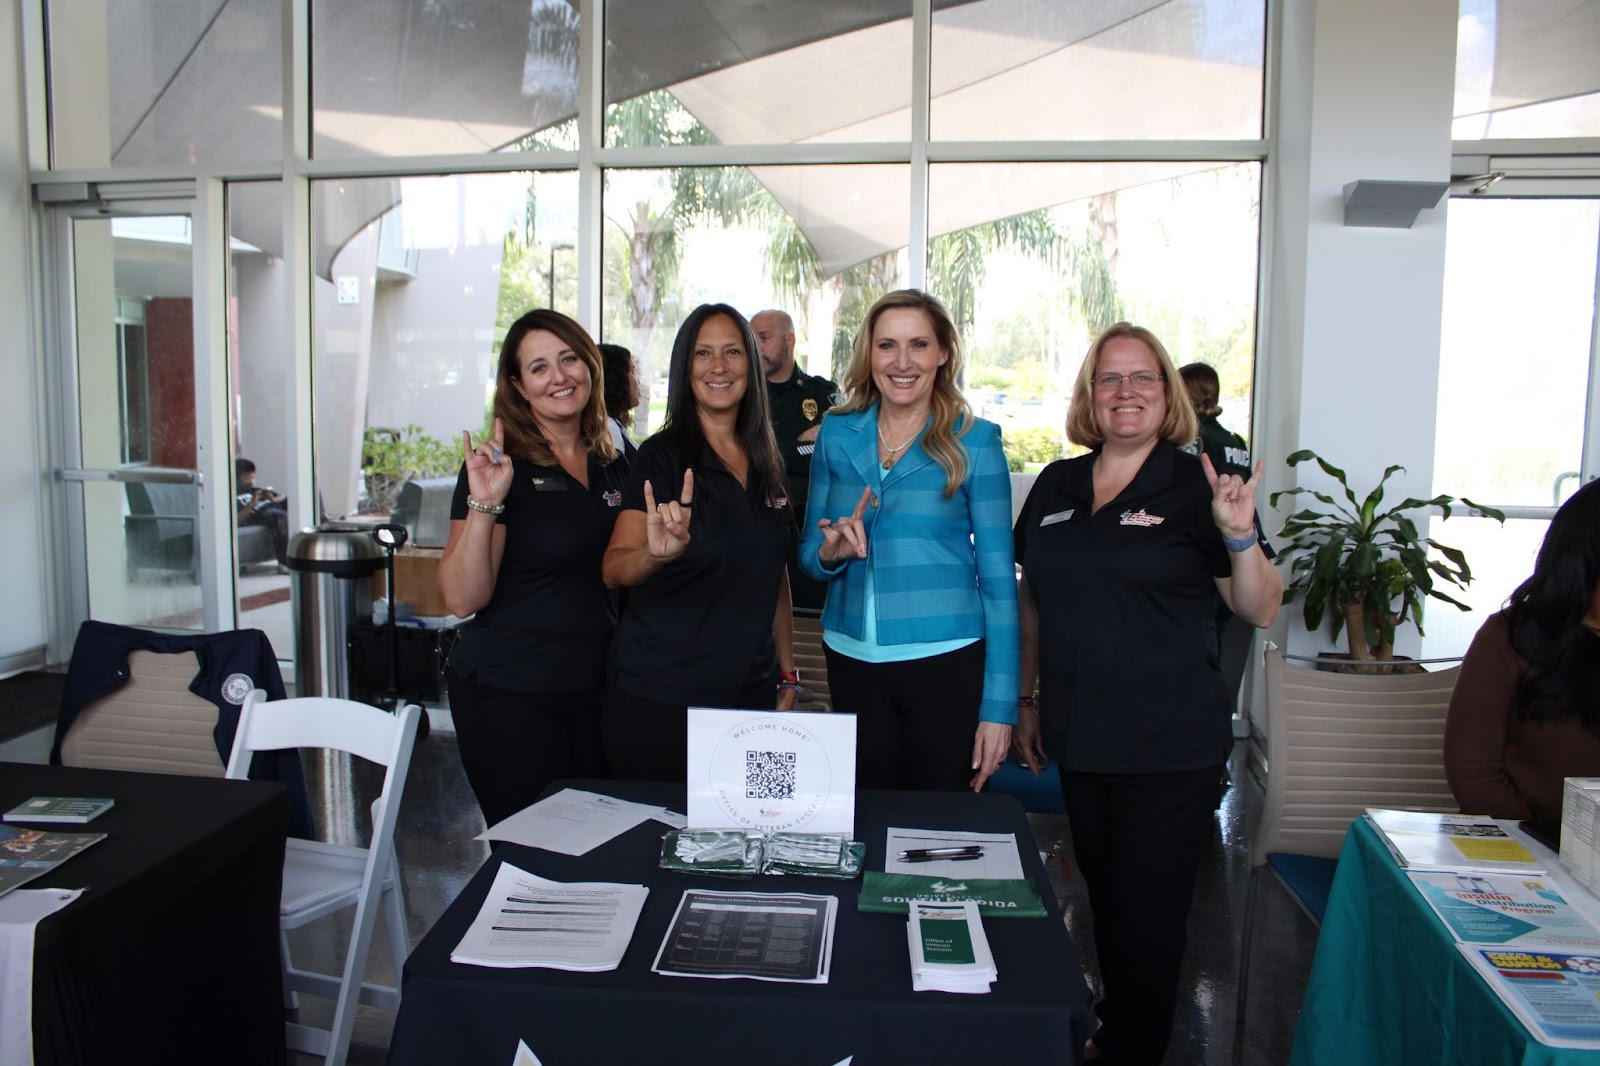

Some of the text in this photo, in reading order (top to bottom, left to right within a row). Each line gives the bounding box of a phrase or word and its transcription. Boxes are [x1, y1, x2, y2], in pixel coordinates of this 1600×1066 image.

[1224, 446, 1250, 467] POLIC
[733, 724, 811, 742] WELCOME HOME!
[719, 790, 738, 817] OFFICE
[740, 817, 750, 825] OF
[754, 822, 793, 831] VETERAN
[1455, 892, 1512, 902] Insulin
[1476, 899, 1556, 909] Distribution
[1500, 905, 1555, 914] Program
